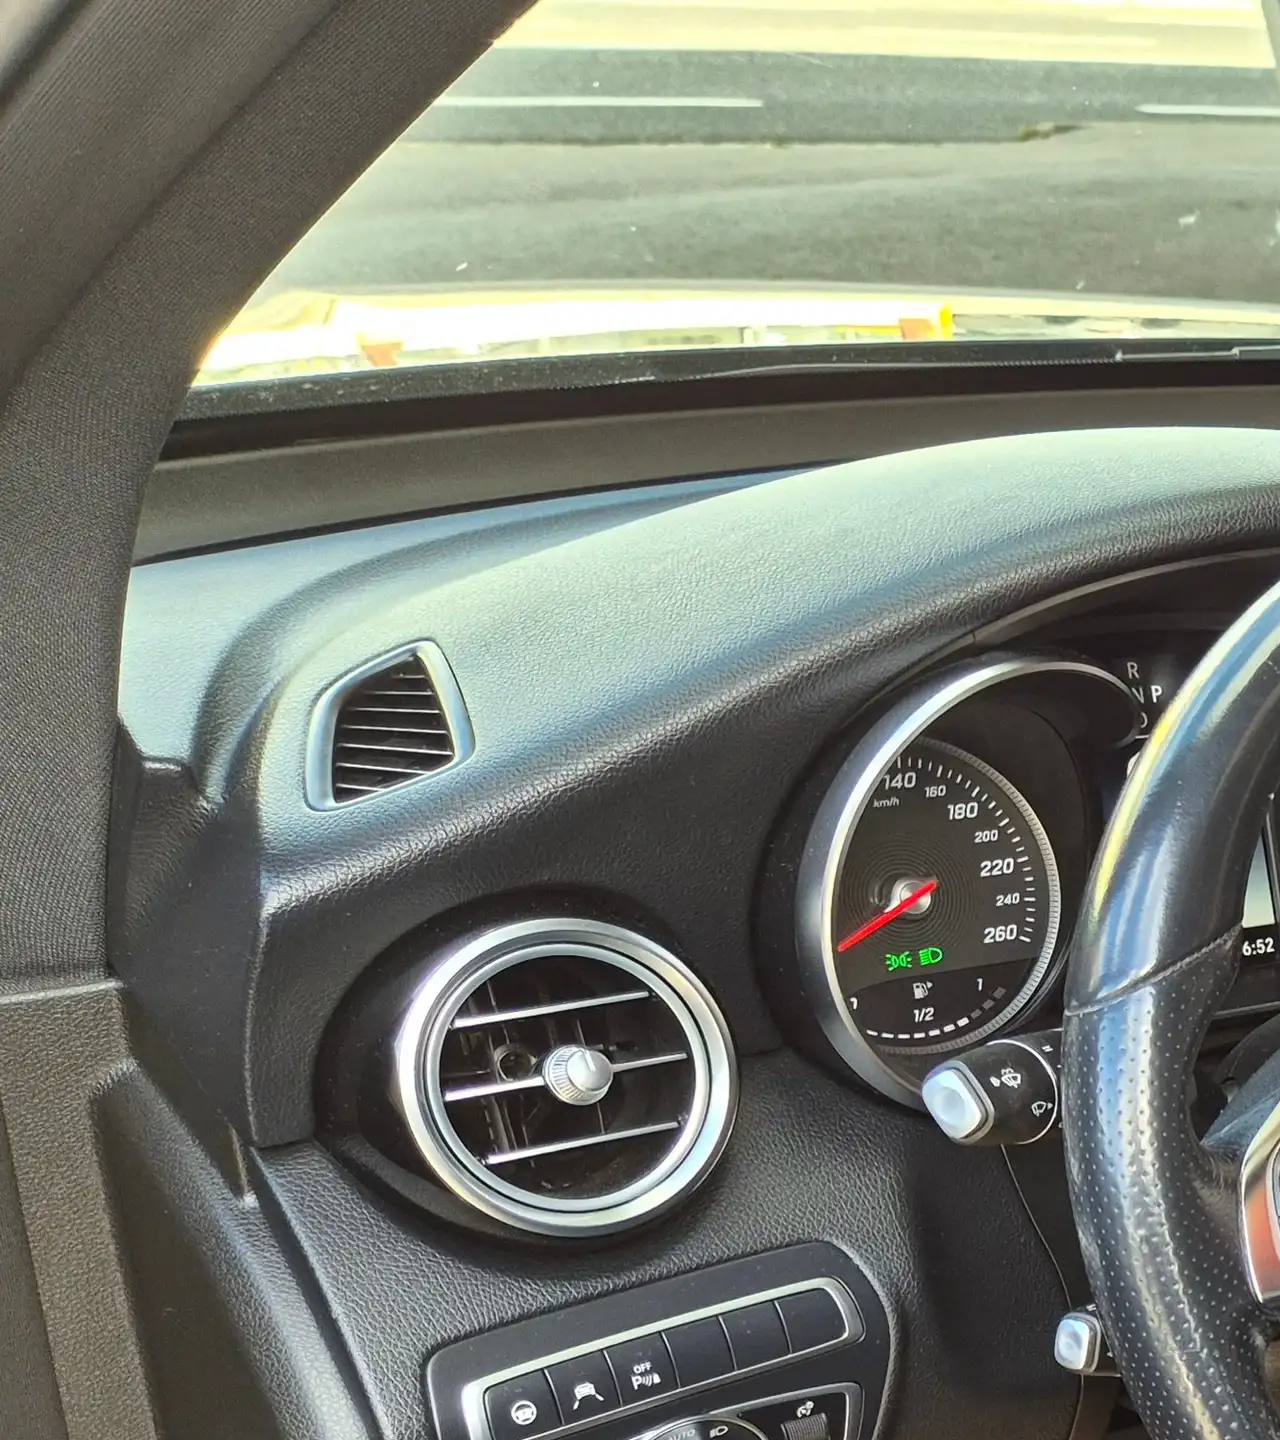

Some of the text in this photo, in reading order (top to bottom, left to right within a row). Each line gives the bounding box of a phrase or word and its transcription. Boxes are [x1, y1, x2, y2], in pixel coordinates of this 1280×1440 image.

[1126, 661, 1140, 680] R
[1150, 684, 1163, 703] P
[883, 771, 916, 791] 140
[924, 784, 947, 798] 160
[872, 796, 900, 808] km/h
[947, 801, 978, 821] 180
[974, 829, 998, 843] 200
[980, 857, 1014, 877] 220
[995, 892, 1020, 907] 240
[983, 923, 1017, 944] 260
[976, 977, 983, 991] 1
[913, 1006, 935, 1022] 1/2
[633, 1361, 652, 1374] OFF
